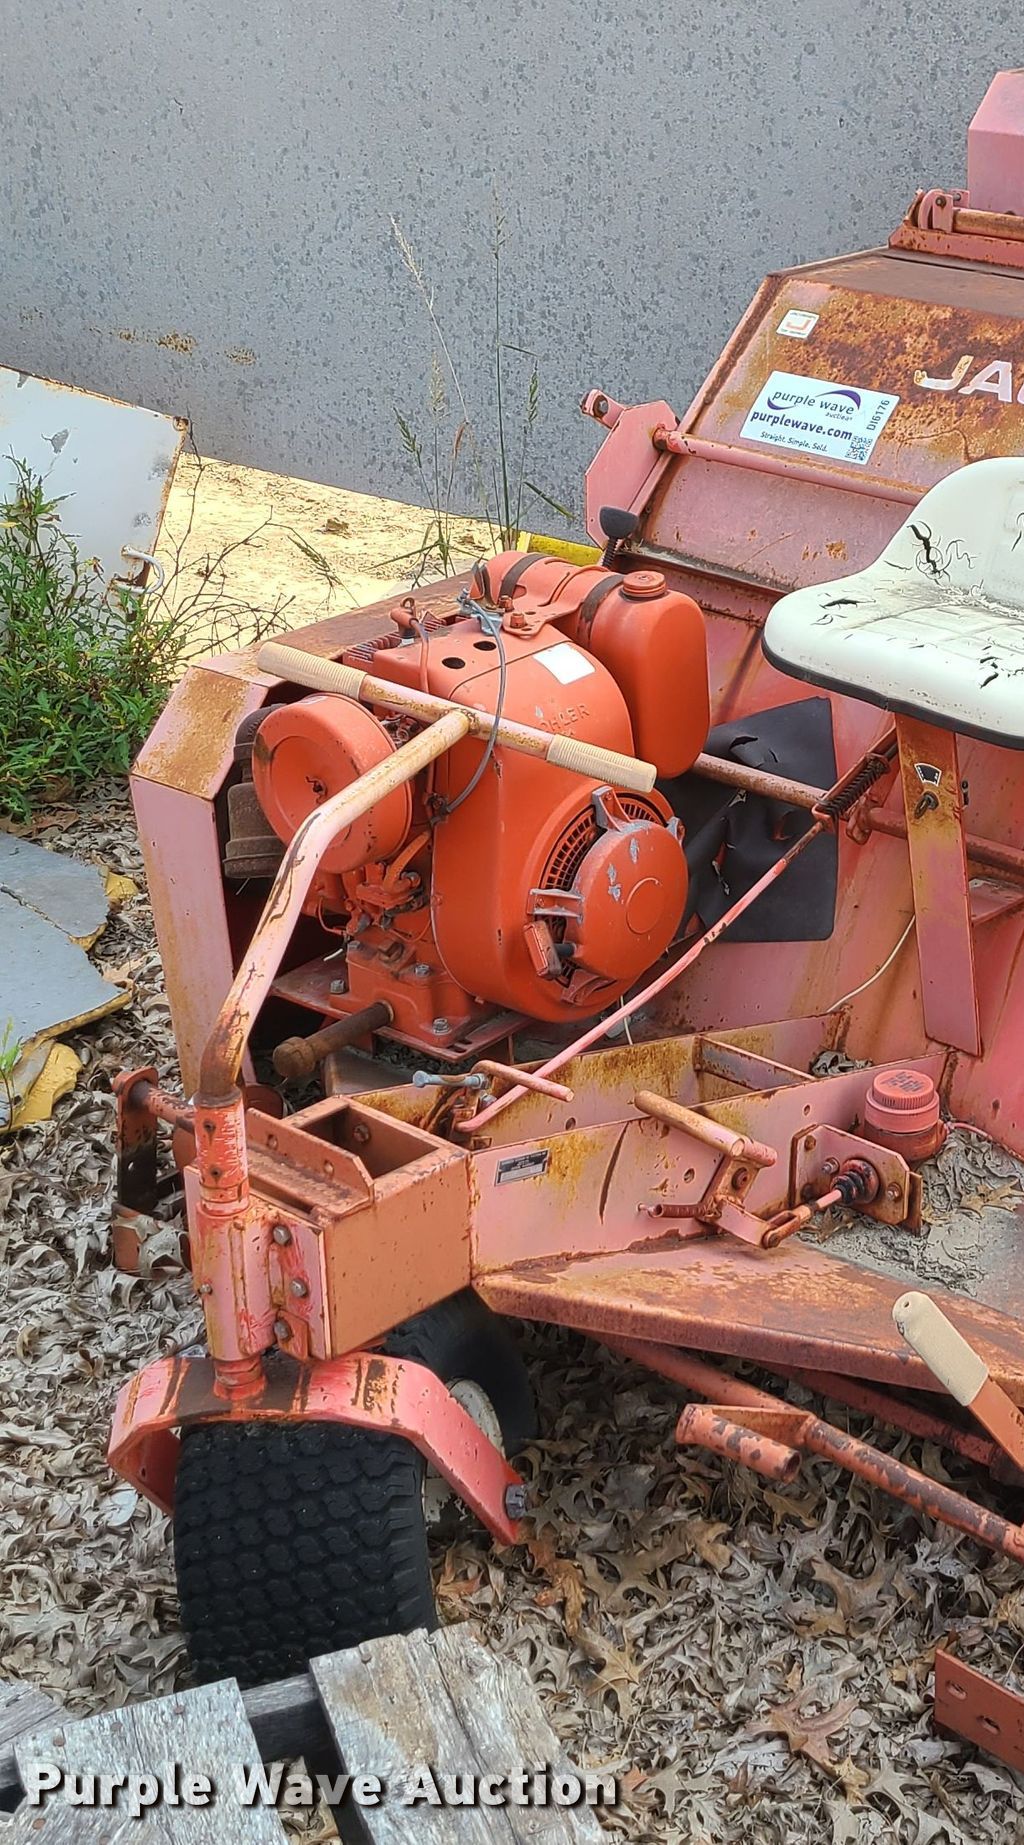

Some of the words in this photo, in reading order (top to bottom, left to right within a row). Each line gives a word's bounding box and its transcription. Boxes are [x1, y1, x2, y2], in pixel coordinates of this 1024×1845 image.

[772, 391, 815, 407] purple
[820, 399, 855, 415] wave
[866, 400, 890, 431] DI6176
[750, 411, 853, 440] purplewave.com
